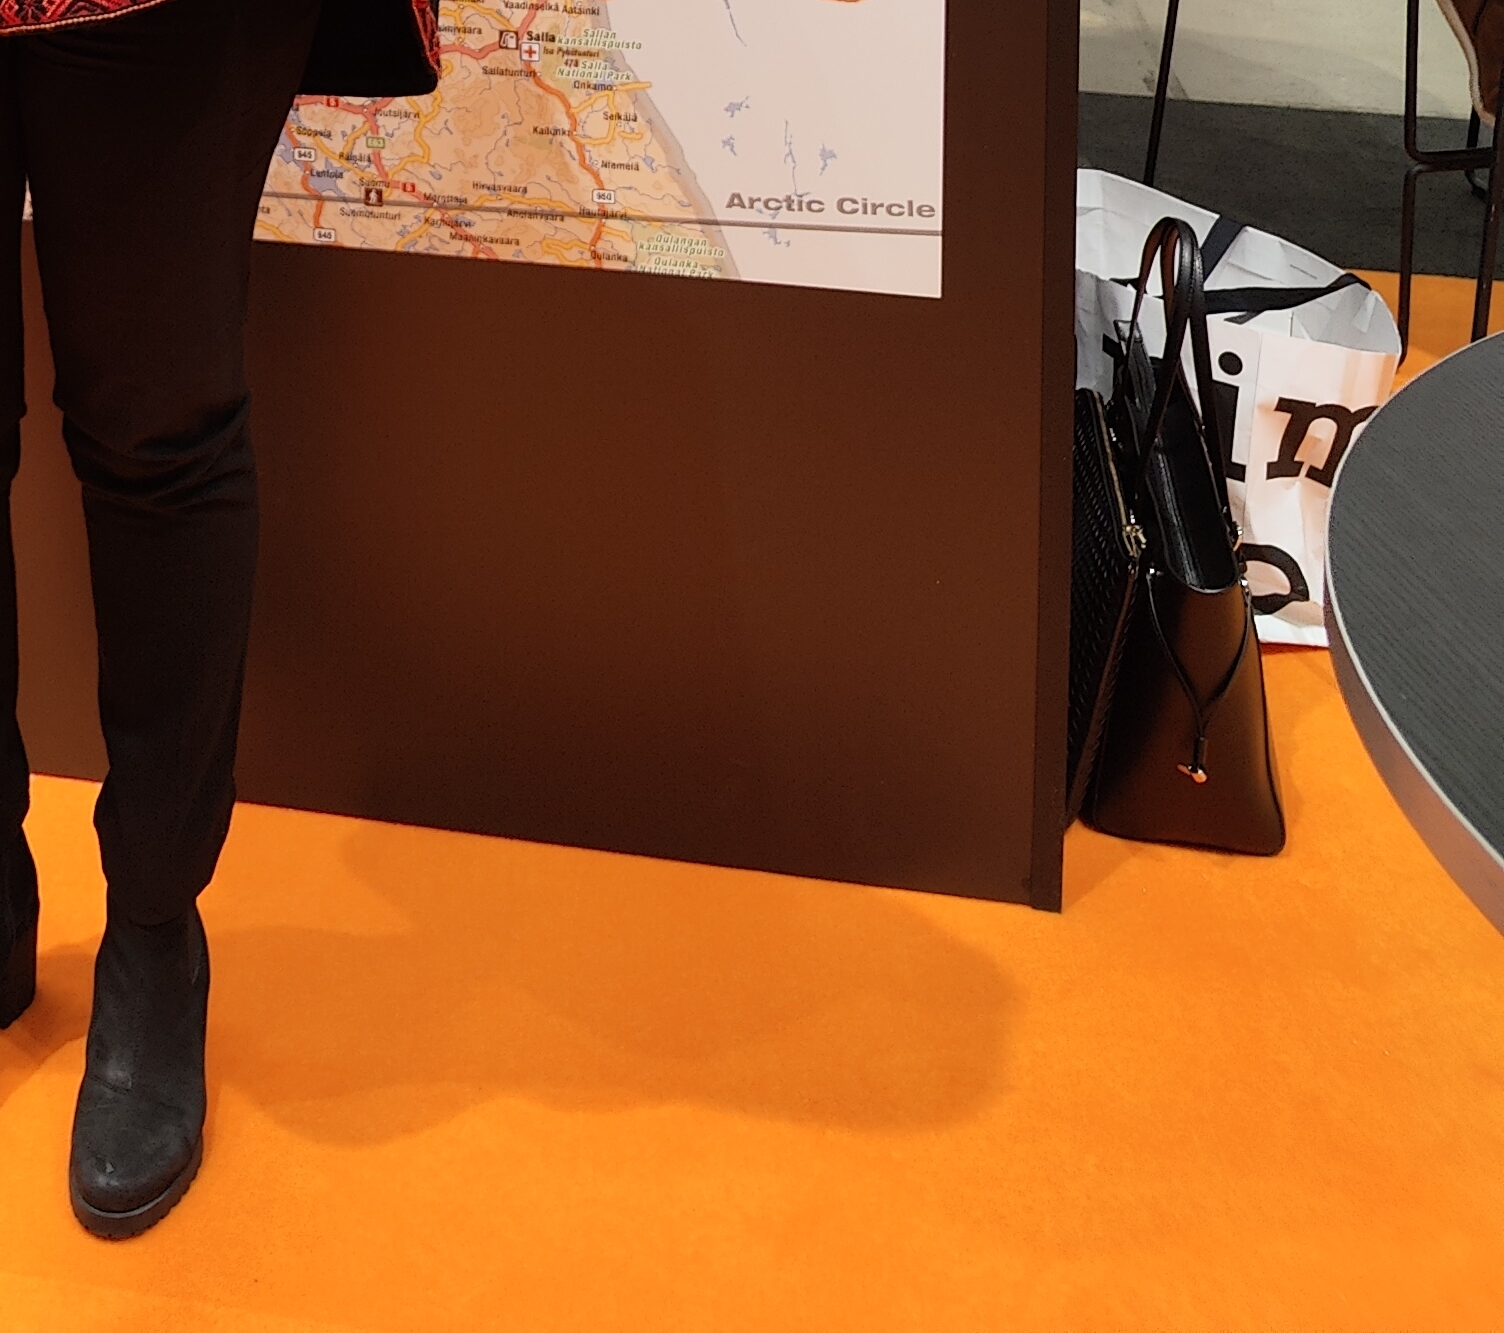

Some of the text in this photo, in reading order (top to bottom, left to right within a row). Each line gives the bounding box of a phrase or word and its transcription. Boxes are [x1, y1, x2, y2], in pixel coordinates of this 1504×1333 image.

[526, 31, 556, 43] Salla
[725, 192, 936, 218] Arctic Circle
